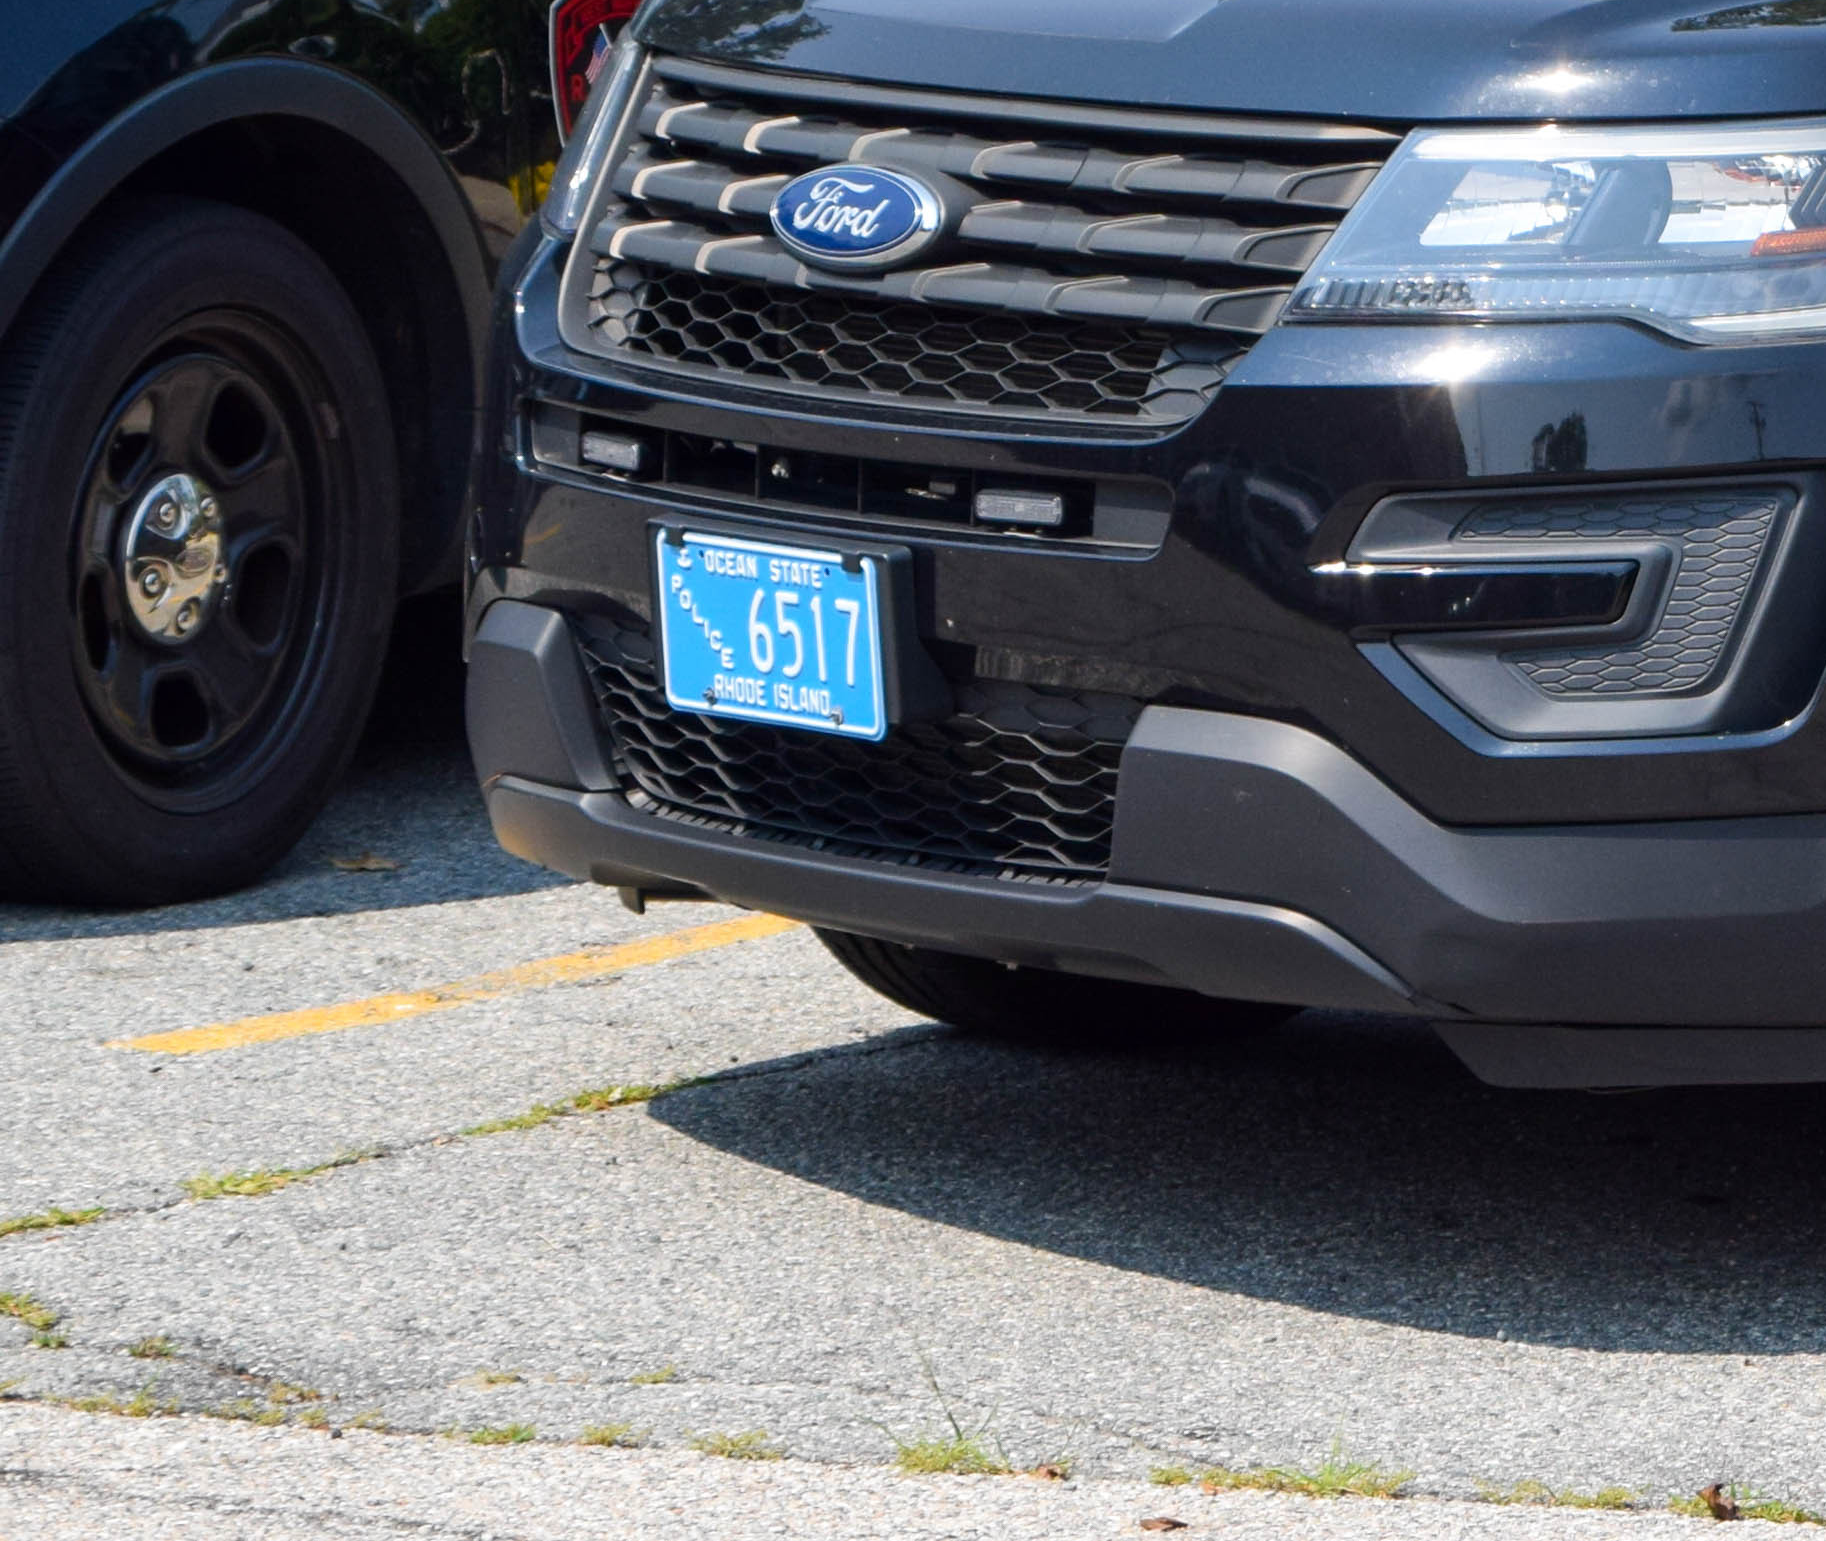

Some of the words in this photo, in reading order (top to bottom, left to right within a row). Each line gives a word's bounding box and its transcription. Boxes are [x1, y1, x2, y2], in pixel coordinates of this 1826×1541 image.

[792, 176, 891, 238] Ford
[703, 549, 759, 579] OCEAN
[769, 559, 823, 588] STATE
[671, 574, 735, 670] POLICE
[749, 587, 860, 687] 6517
[713, 673, 768, 707] RHODE
[773, 682, 831, 715] ISLAND
